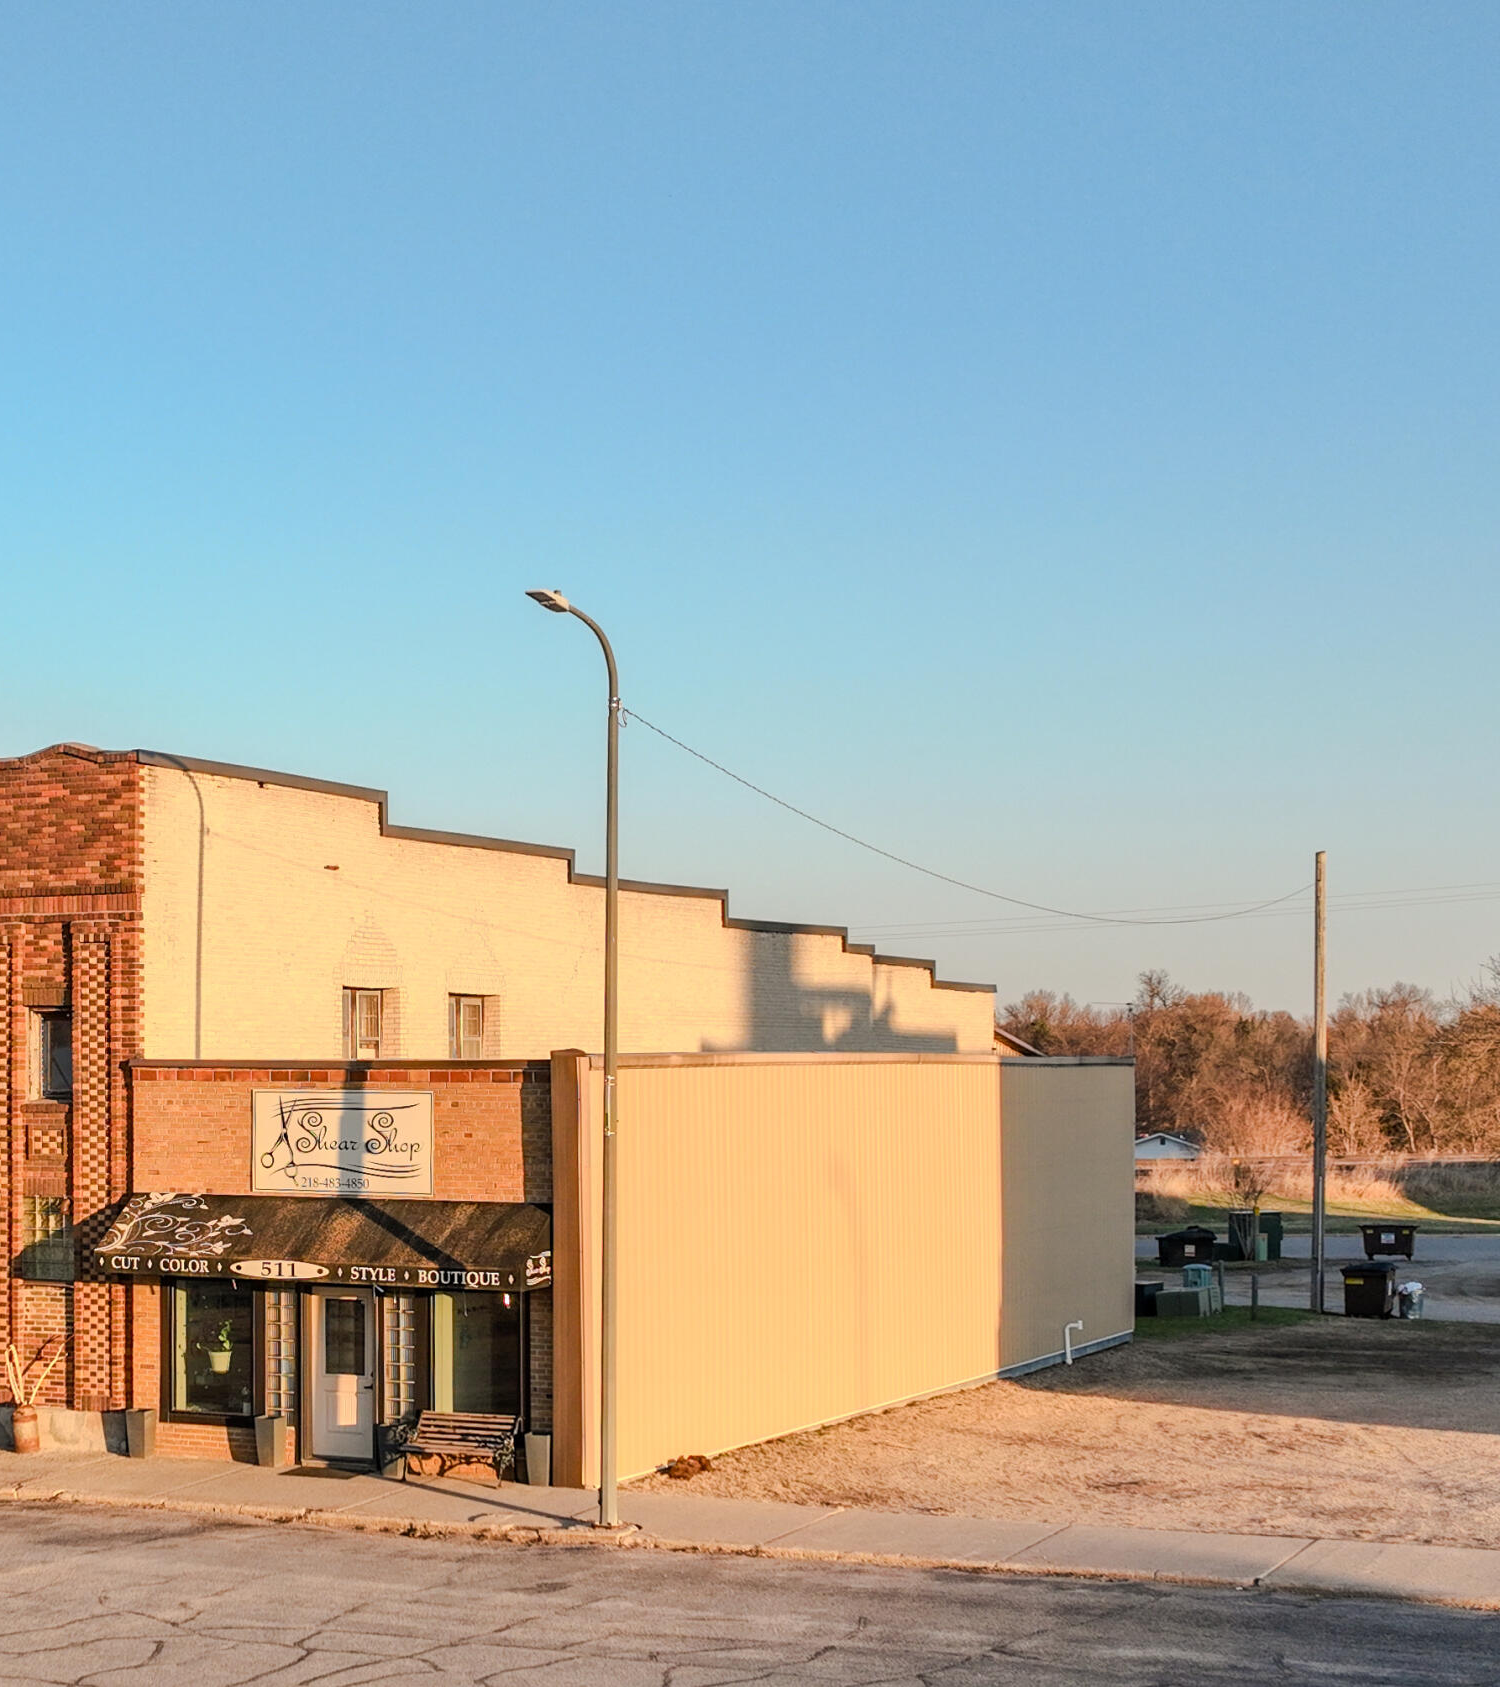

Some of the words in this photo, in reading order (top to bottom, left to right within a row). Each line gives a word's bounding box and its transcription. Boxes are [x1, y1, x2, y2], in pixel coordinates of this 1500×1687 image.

[296, 1111, 358, 1153] Shear
[365, 1112, 421, 1161] Shop
[301, 1176, 370, 1189] 218-483-4850
[111, 1255, 140, 1270] CUT
[159, 1258, 209, 1273] COLOR
[260, 1262, 297, 1277] 511
[350, 1266, 396, 1282] STYLE
[417, 1269, 501, 1288] BOUTIQUE
